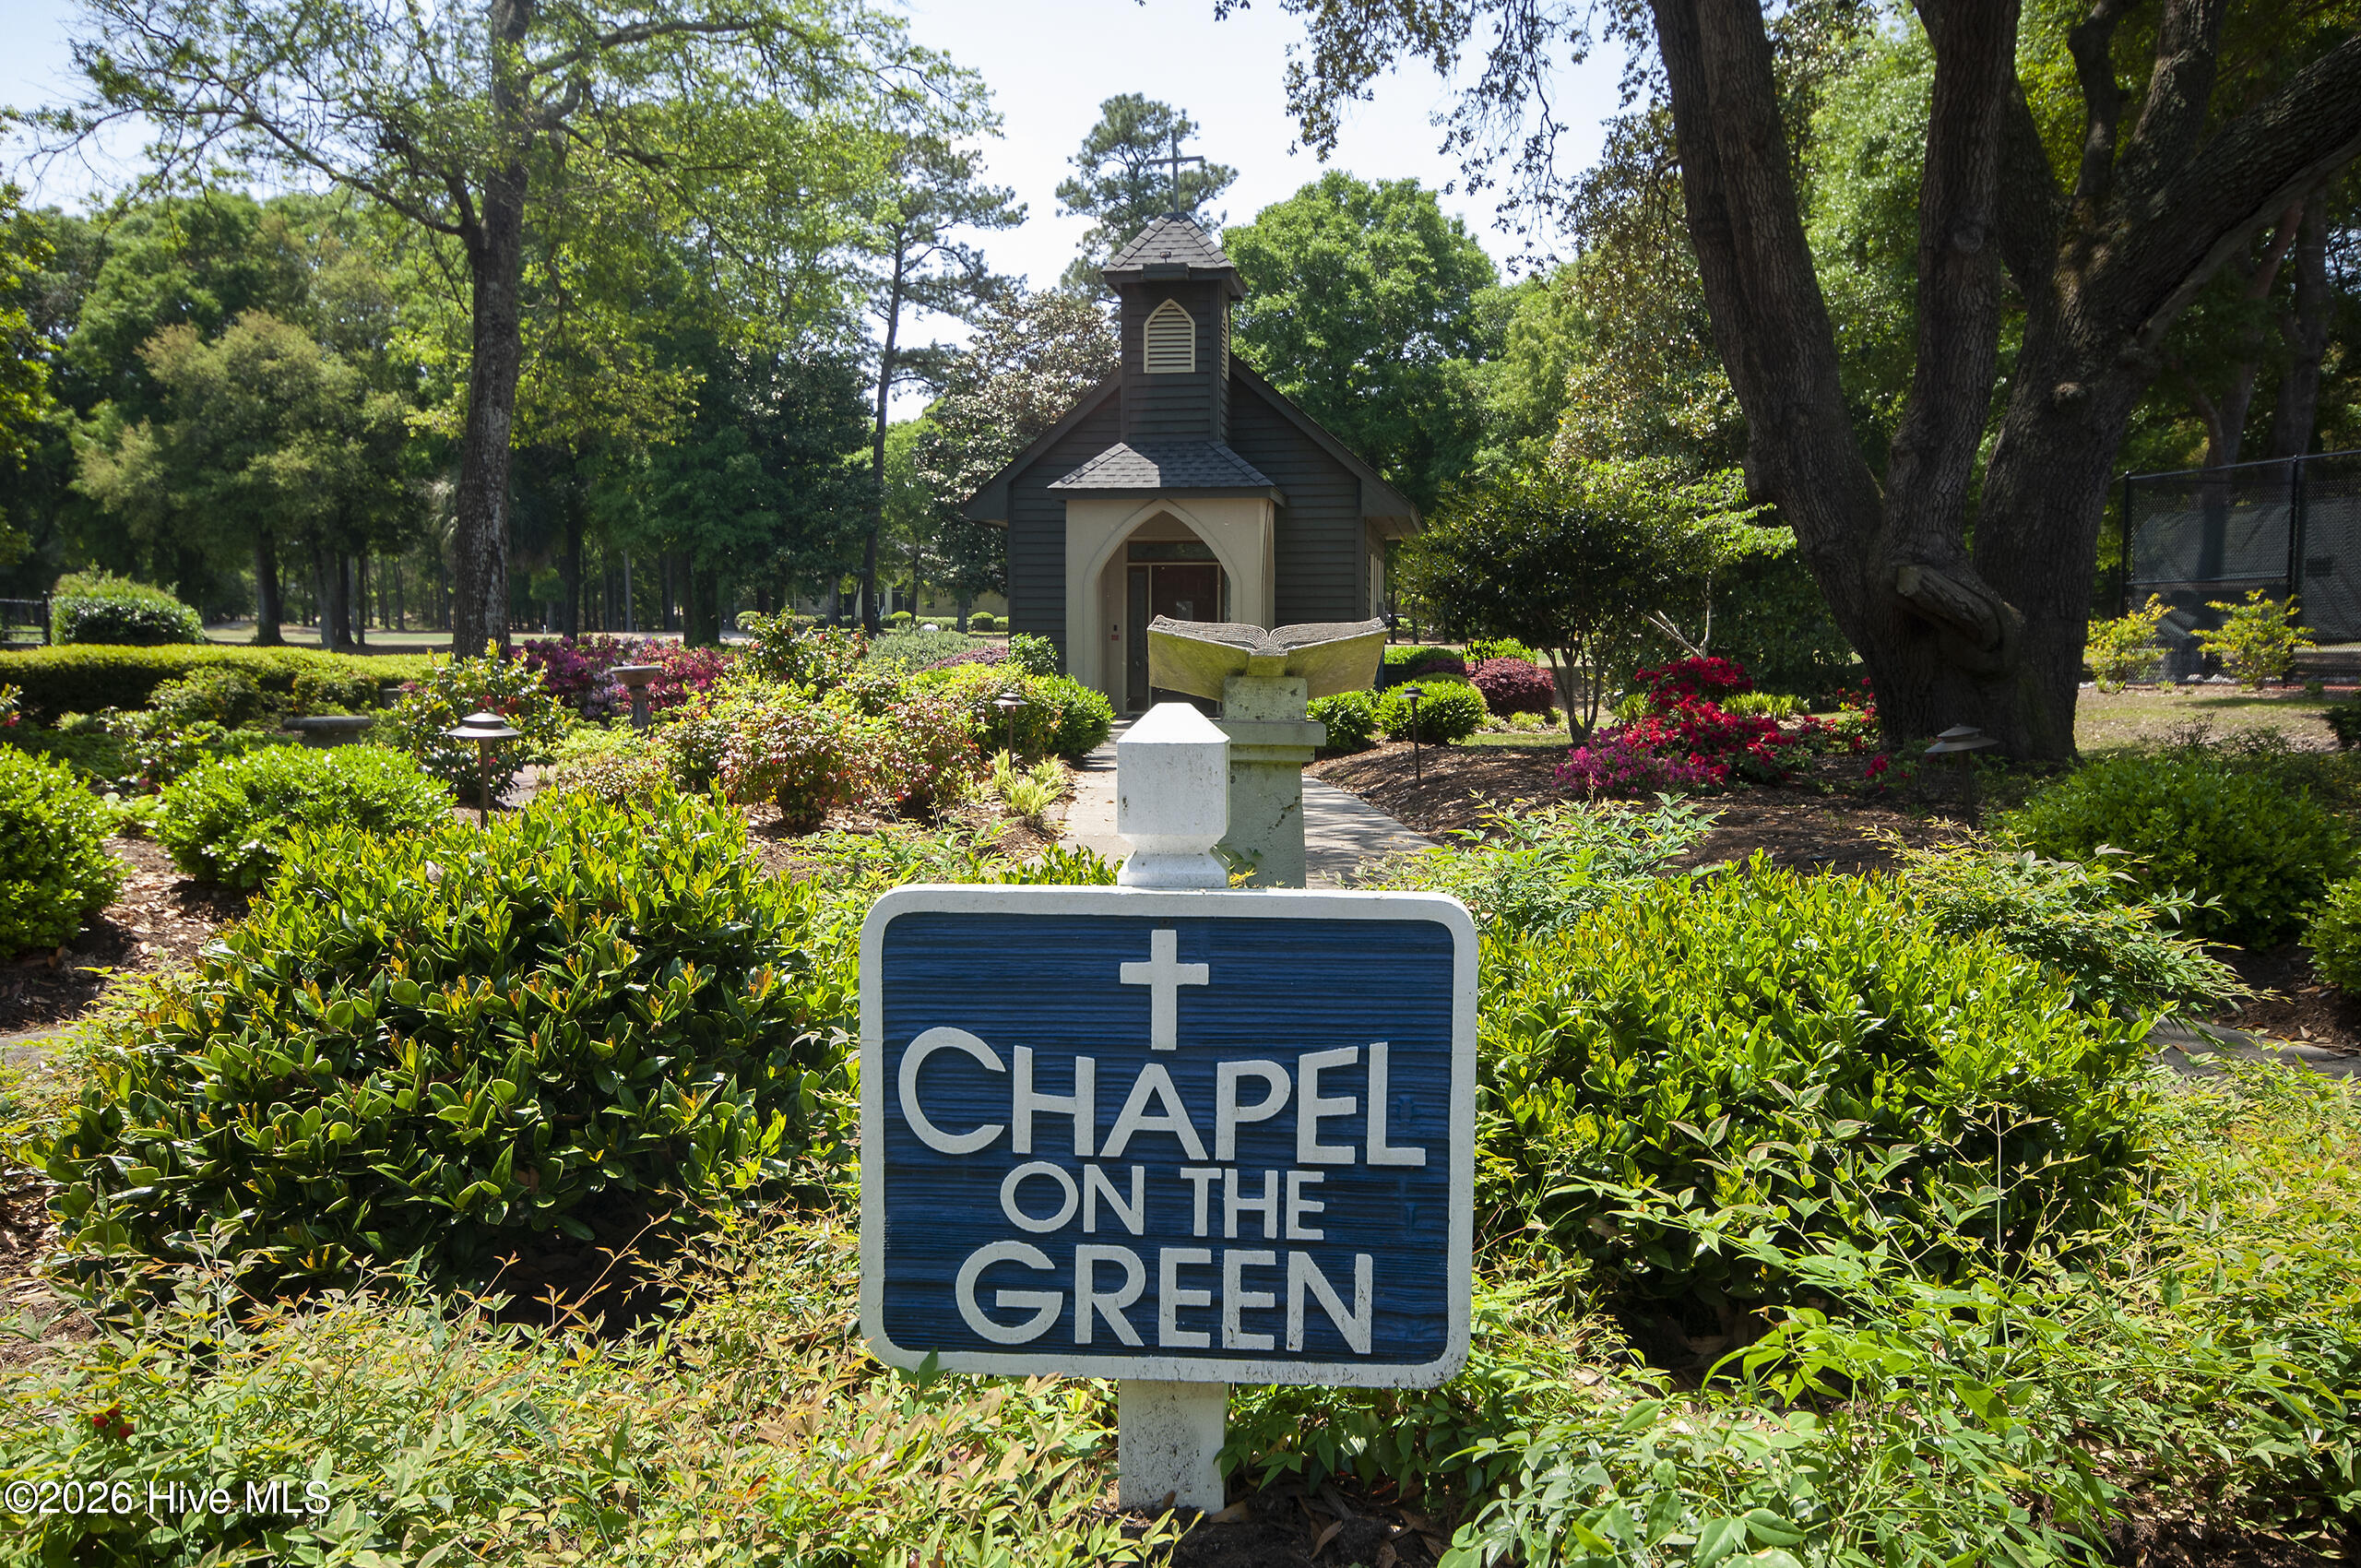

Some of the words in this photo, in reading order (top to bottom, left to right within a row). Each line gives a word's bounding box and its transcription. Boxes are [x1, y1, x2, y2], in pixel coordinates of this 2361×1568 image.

[898, 1026, 1427, 1166] CHAPEL
[1000, 1160, 1145, 1236] ON
[1180, 1166, 1326, 1241] THE
[955, 1240, 1374, 1355] GREEN
